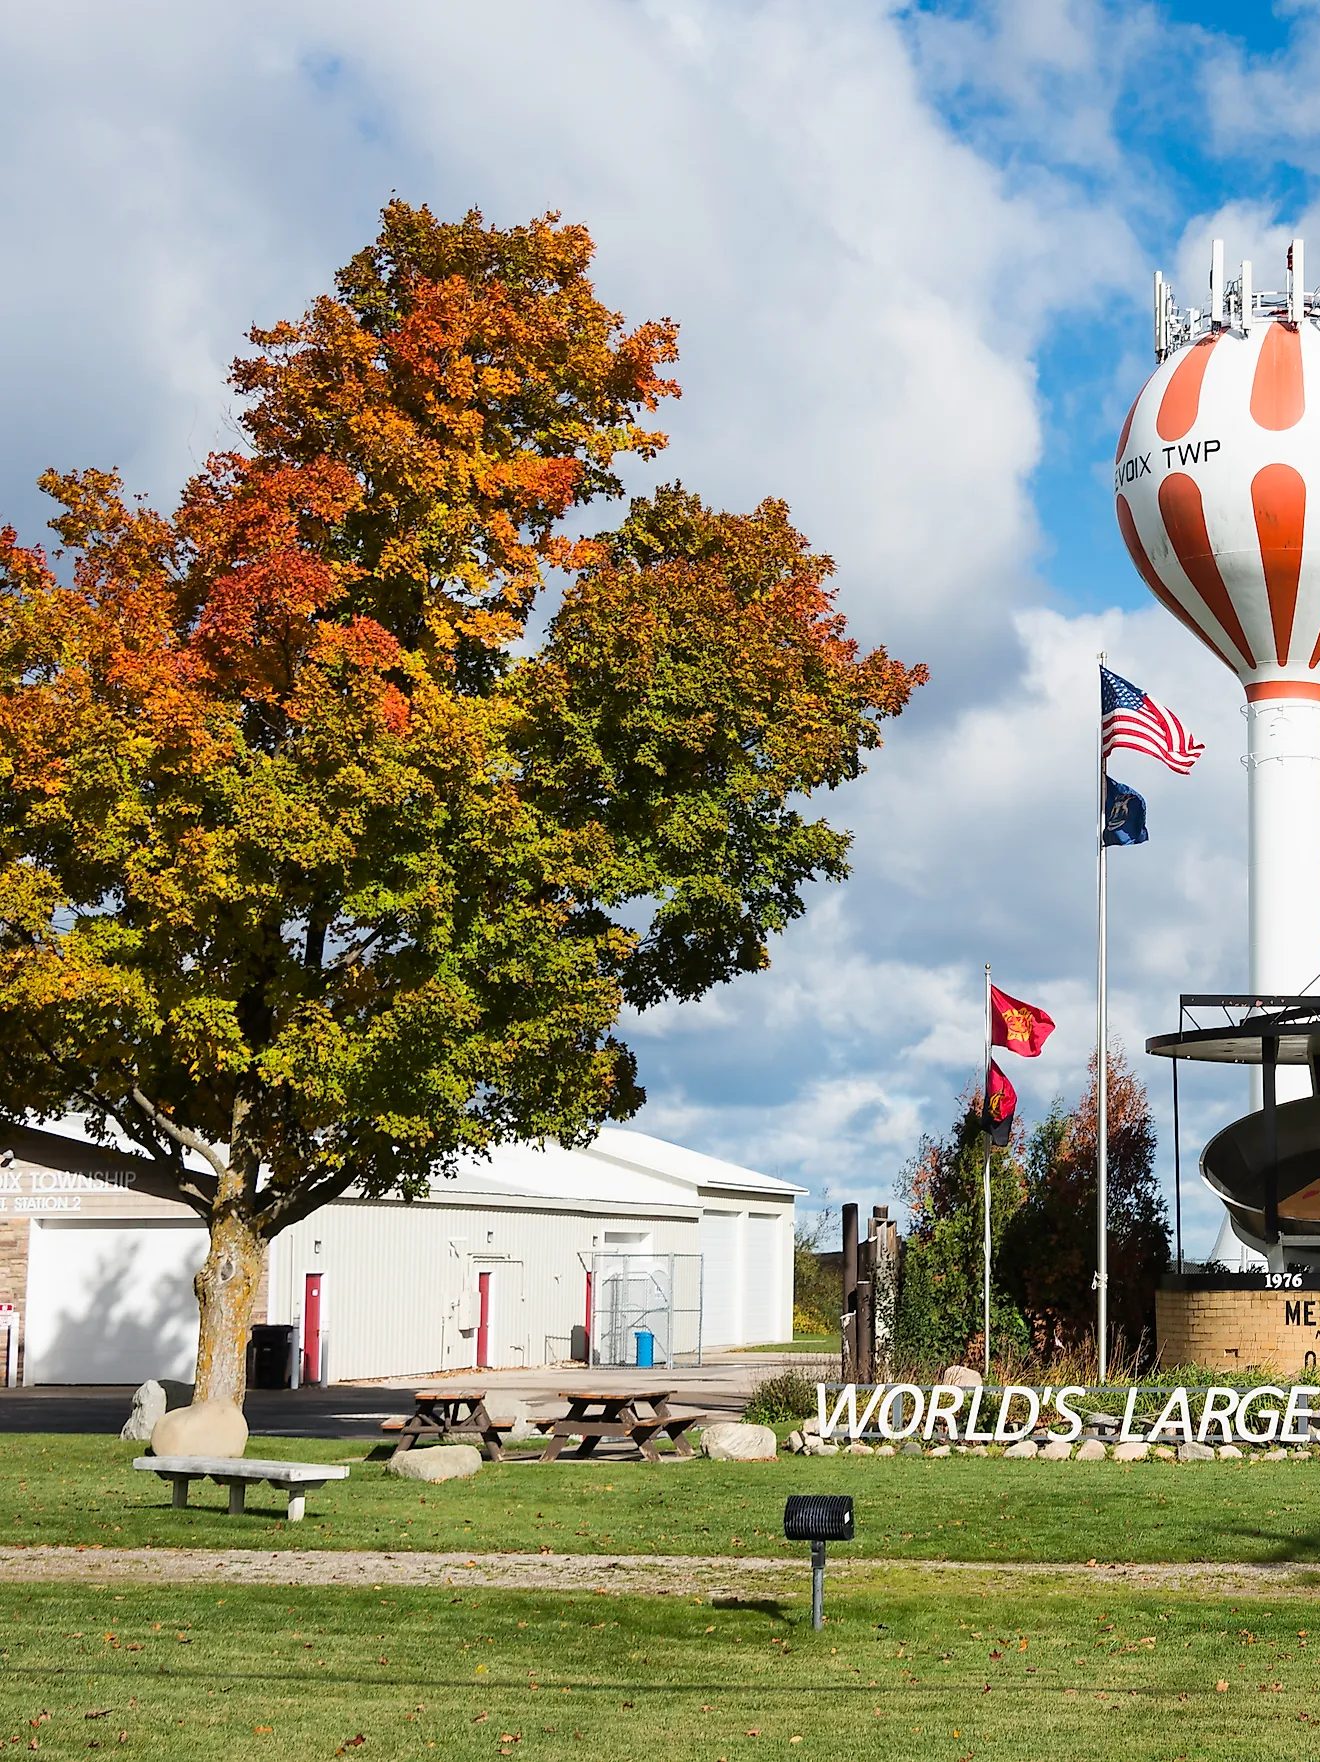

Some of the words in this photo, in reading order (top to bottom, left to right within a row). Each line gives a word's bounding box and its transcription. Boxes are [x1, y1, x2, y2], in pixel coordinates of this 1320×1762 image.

[1161, 439, 1221, 469] TWP
[0, 1171, 22, 1190] IX
[30, 1171, 137, 1191] TOWNSHIP
[15, 1196, 68, 1210] STATION
[71, 1196, 81, 1210] 2
[1265, 1273, 1303, 1288] 1976
[816, 1383, 1087, 1442] WORLD'S
